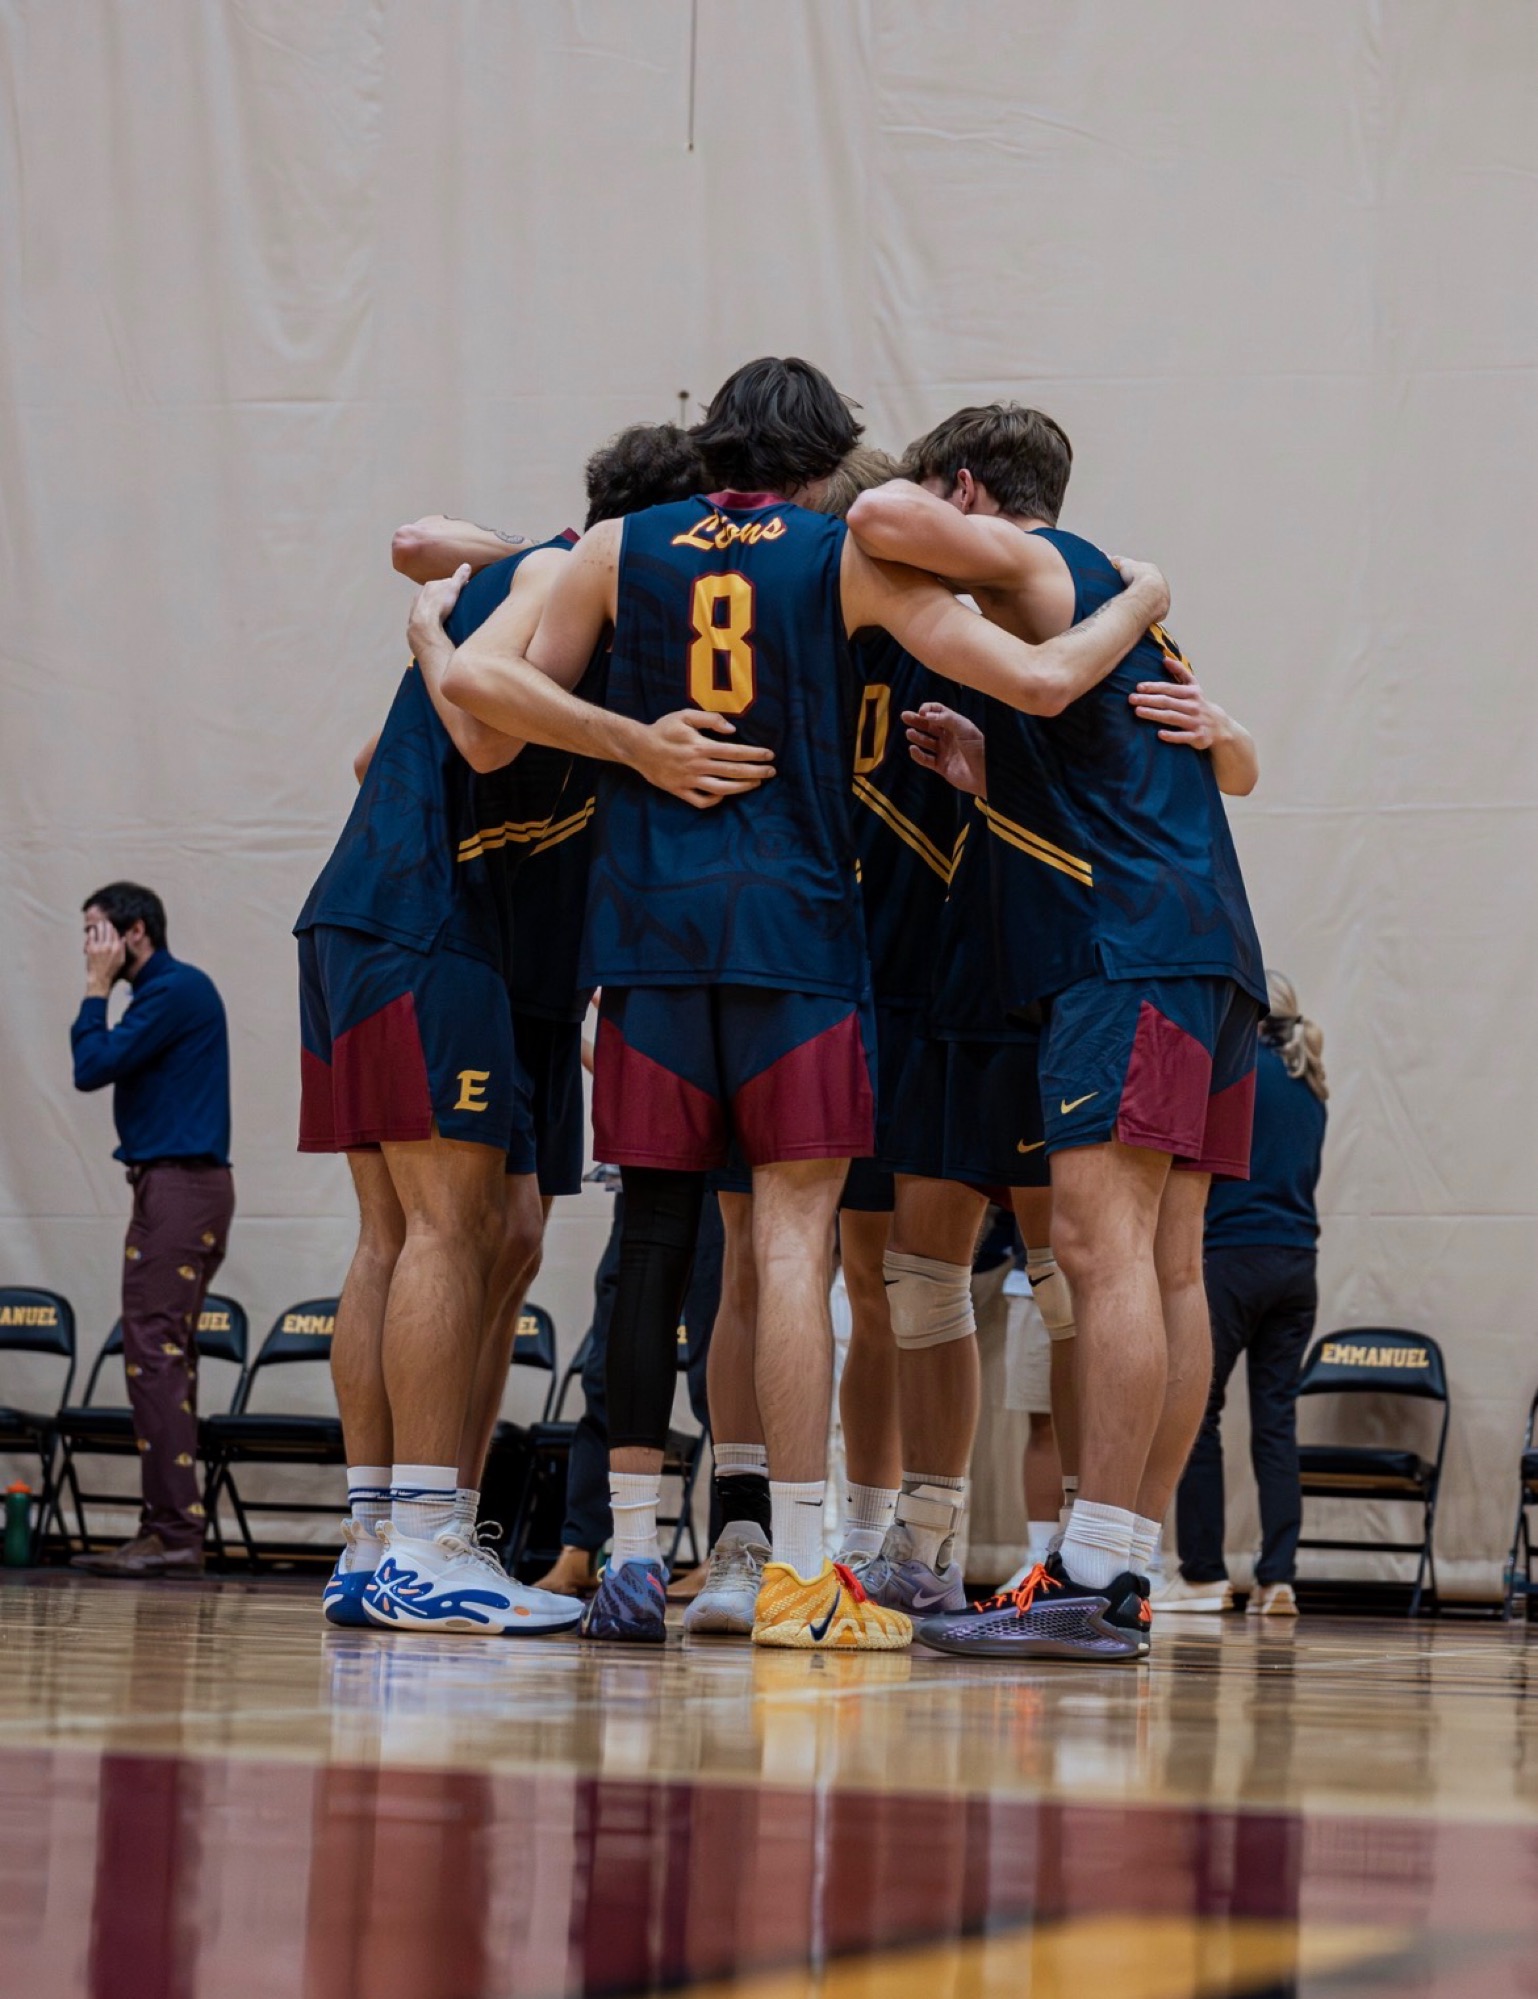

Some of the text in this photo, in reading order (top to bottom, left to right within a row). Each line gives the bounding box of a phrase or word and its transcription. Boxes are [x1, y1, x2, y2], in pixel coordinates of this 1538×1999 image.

[687, 571, 756, 717] 8
[453, 1070, 490, 1112] E
[0, 1306, 58, 1327] ANUEL
[283, 1313, 335, 1335] EMMA
[1320, 1342, 1429, 1368] EMMANUEL
